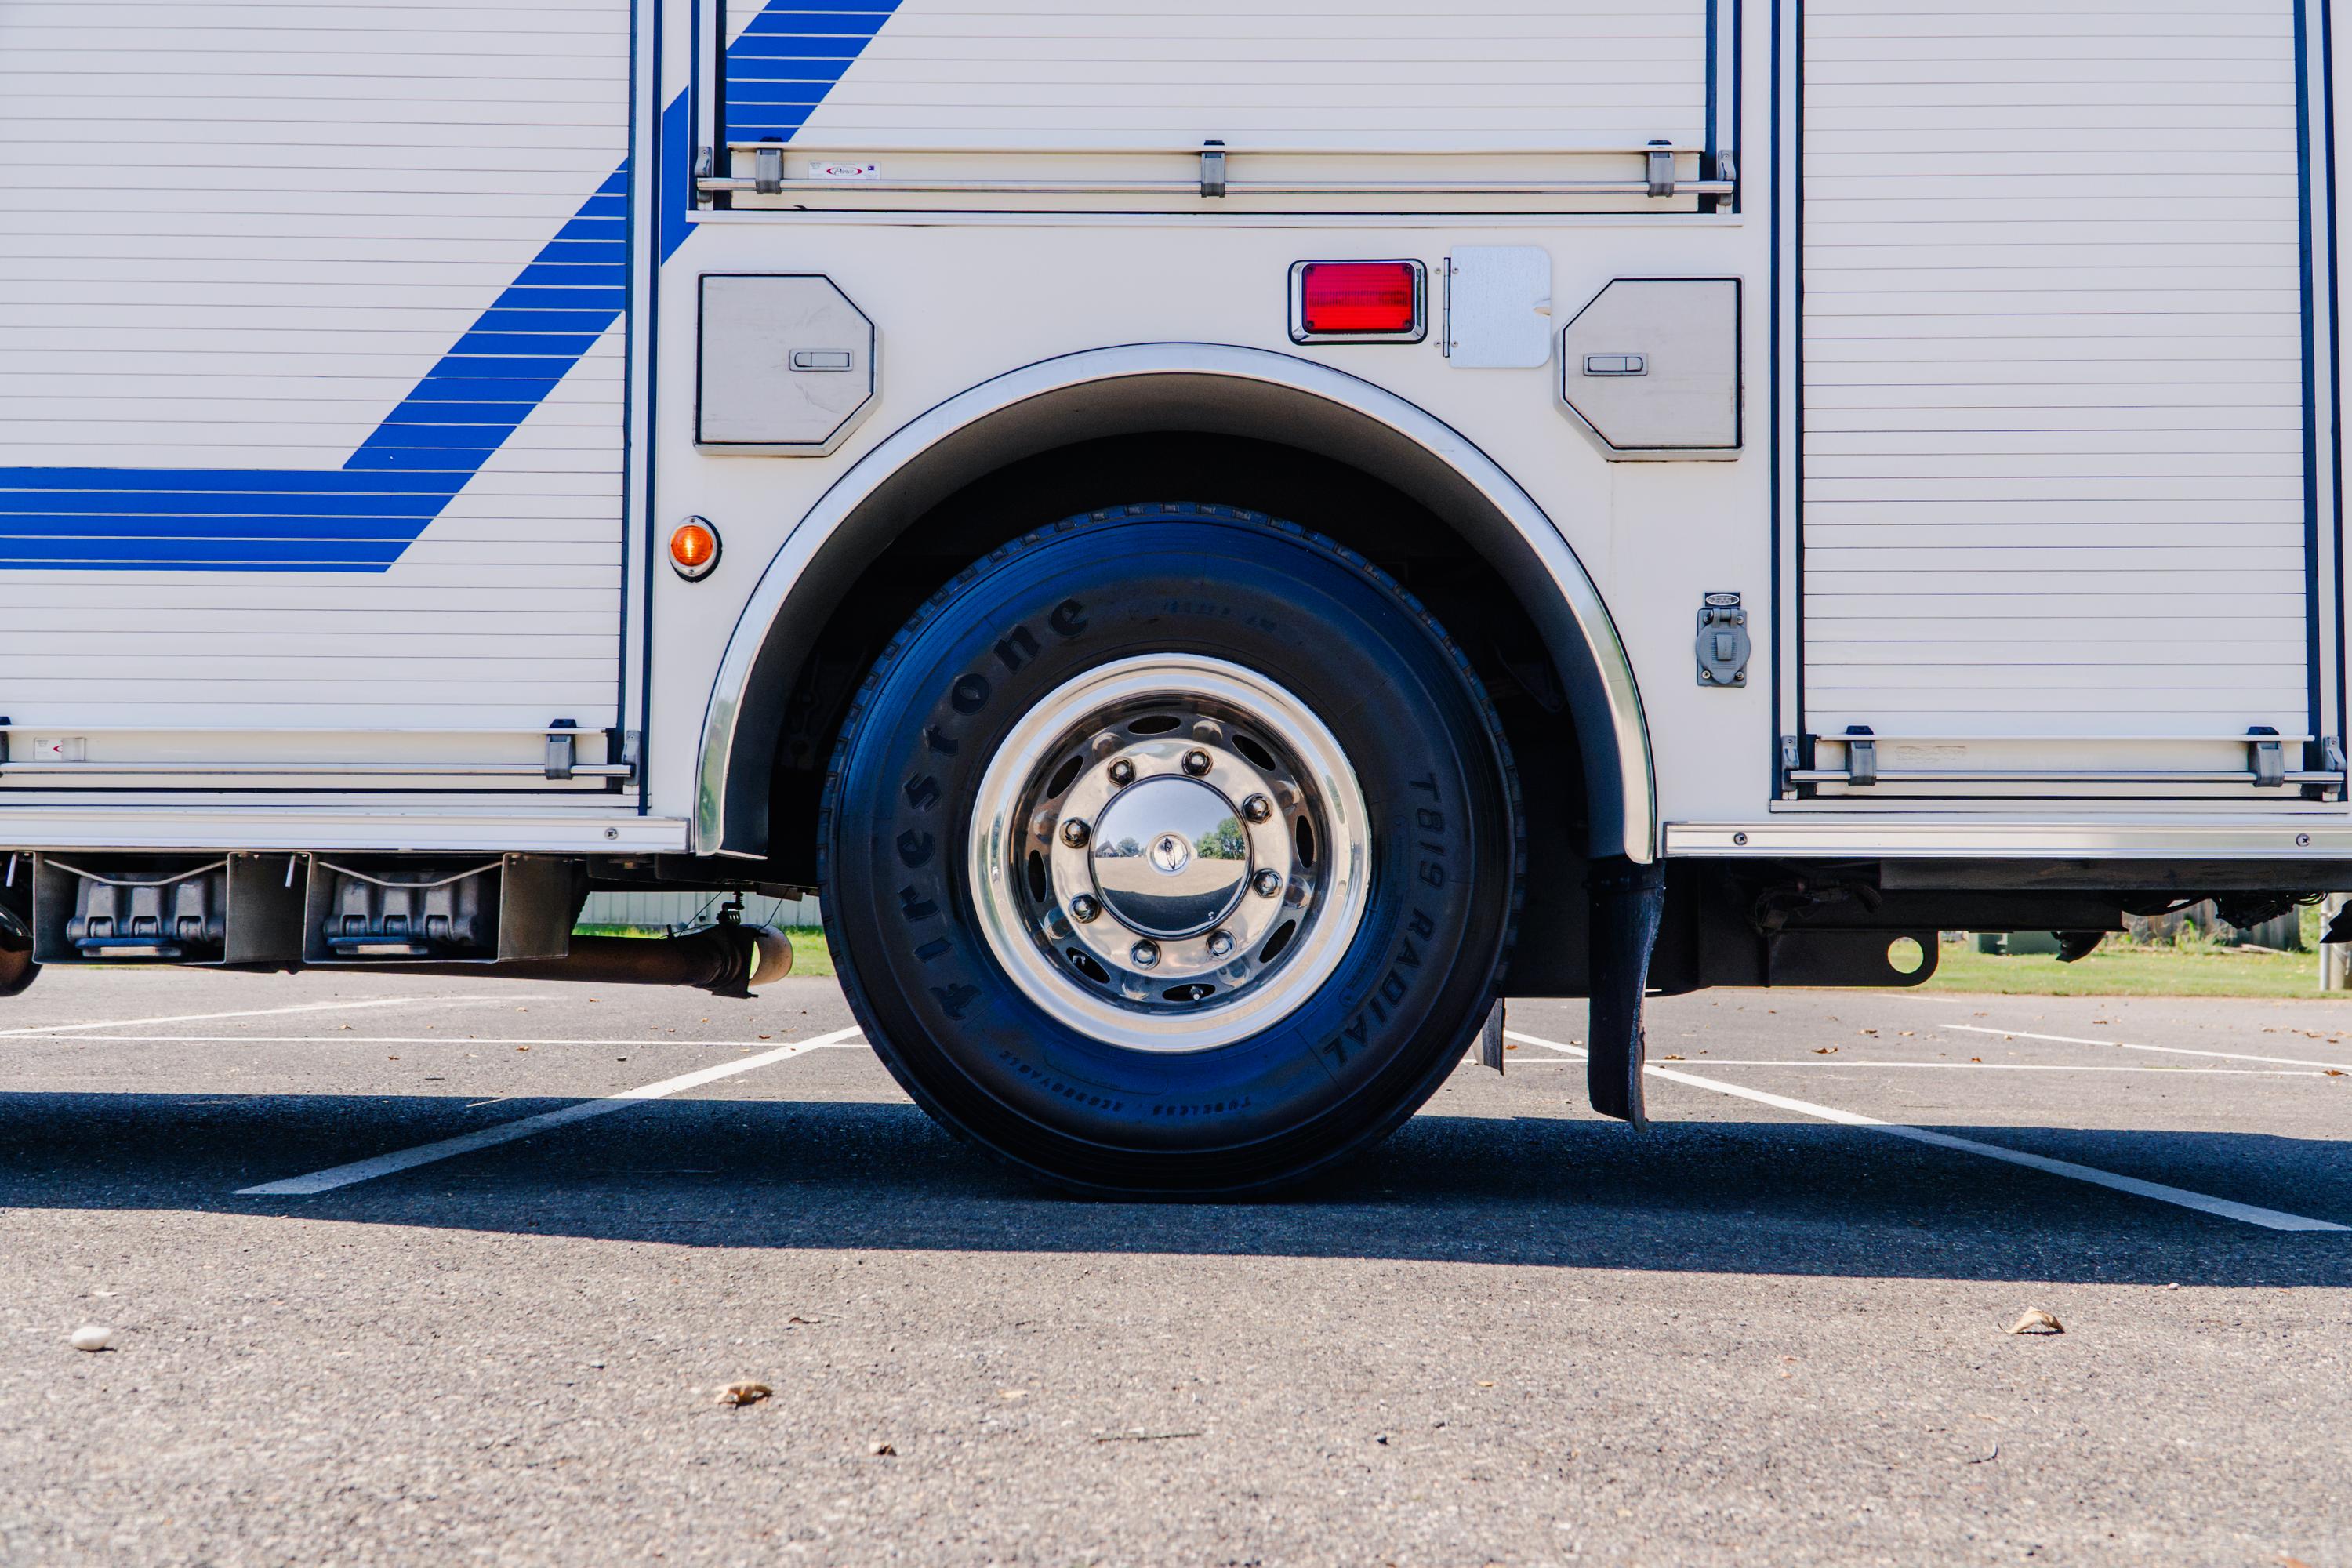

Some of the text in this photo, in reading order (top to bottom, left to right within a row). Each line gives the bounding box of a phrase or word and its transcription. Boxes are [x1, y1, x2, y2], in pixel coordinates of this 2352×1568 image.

[895, 597, 1091, 1020] Firestone
[1410, 772, 1446, 889] T819
[1323, 907, 1436, 1068] RADIAL
